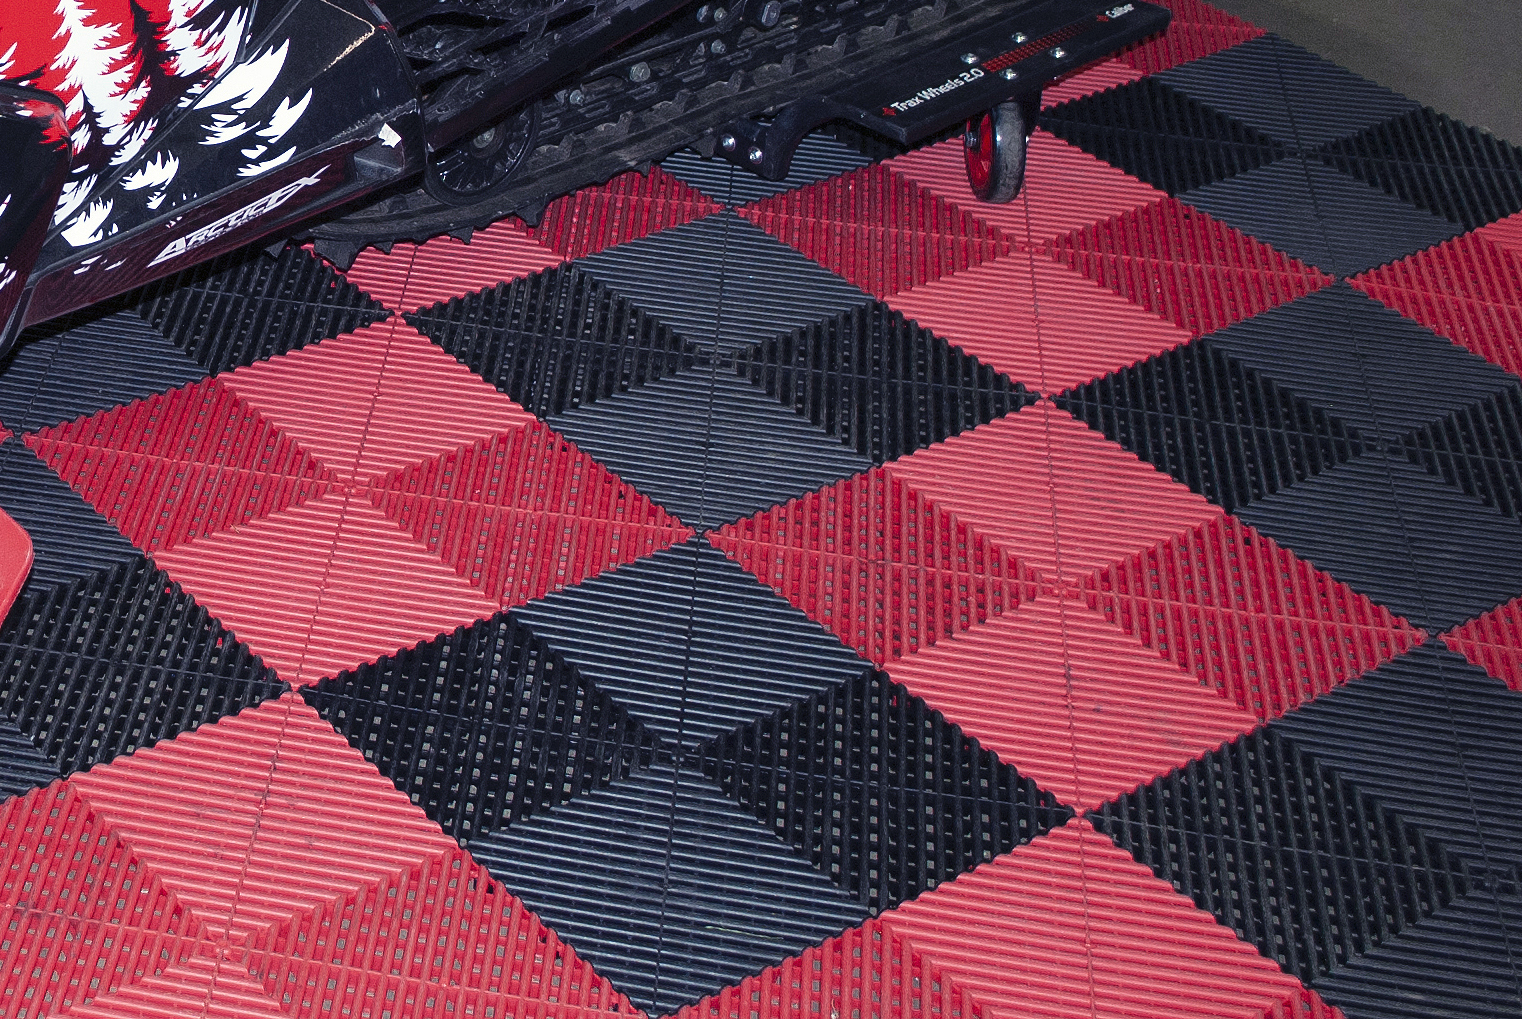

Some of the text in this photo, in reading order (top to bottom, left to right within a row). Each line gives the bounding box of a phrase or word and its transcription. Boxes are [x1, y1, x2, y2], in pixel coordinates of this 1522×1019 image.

[890, 68, 985, 112] Trax Wheels 2.0
